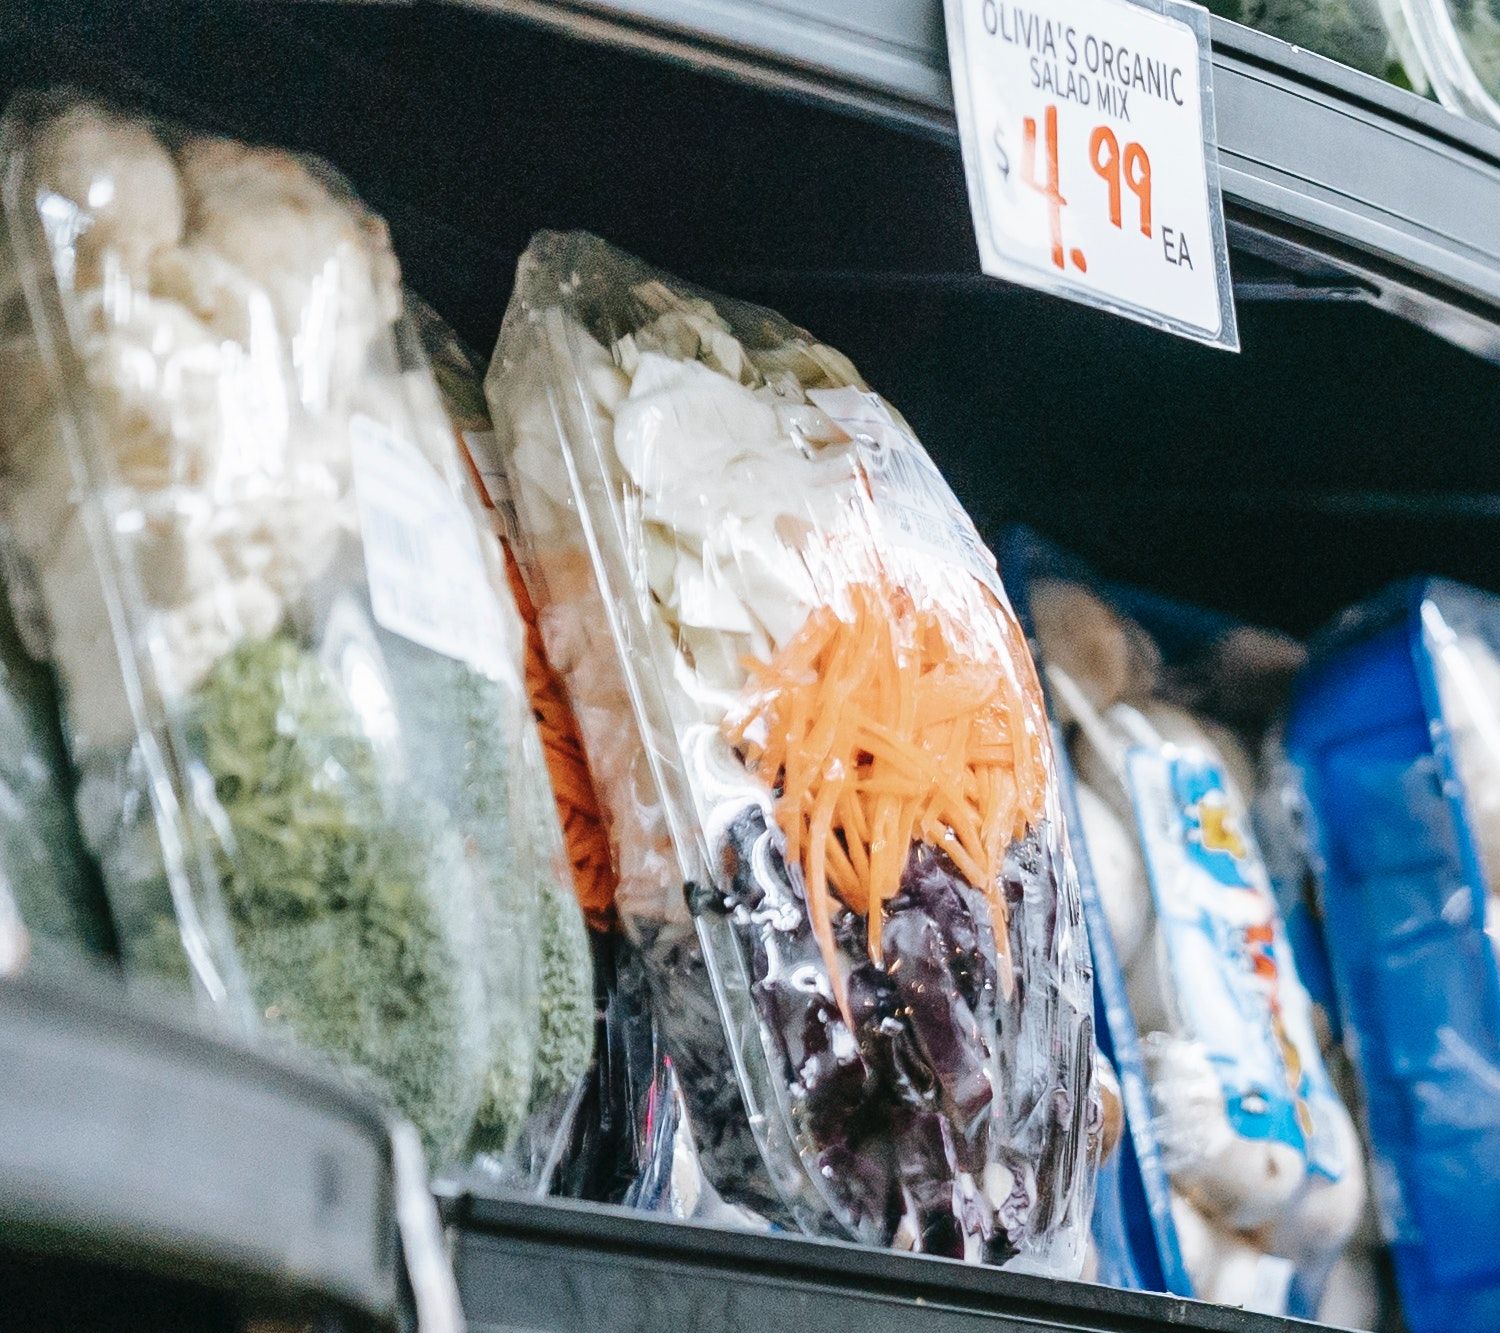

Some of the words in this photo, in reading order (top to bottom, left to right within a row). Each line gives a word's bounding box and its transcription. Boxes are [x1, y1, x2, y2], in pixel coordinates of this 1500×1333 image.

[982, 0, 1077, 66] OLIVIA'S
[1084, 35, 1184, 106] ORGANIC
[1029, 56, 1091, 106] SALAD
[1097, 79, 1130, 122] MIX
[1163, 226, 1194, 271] EA
